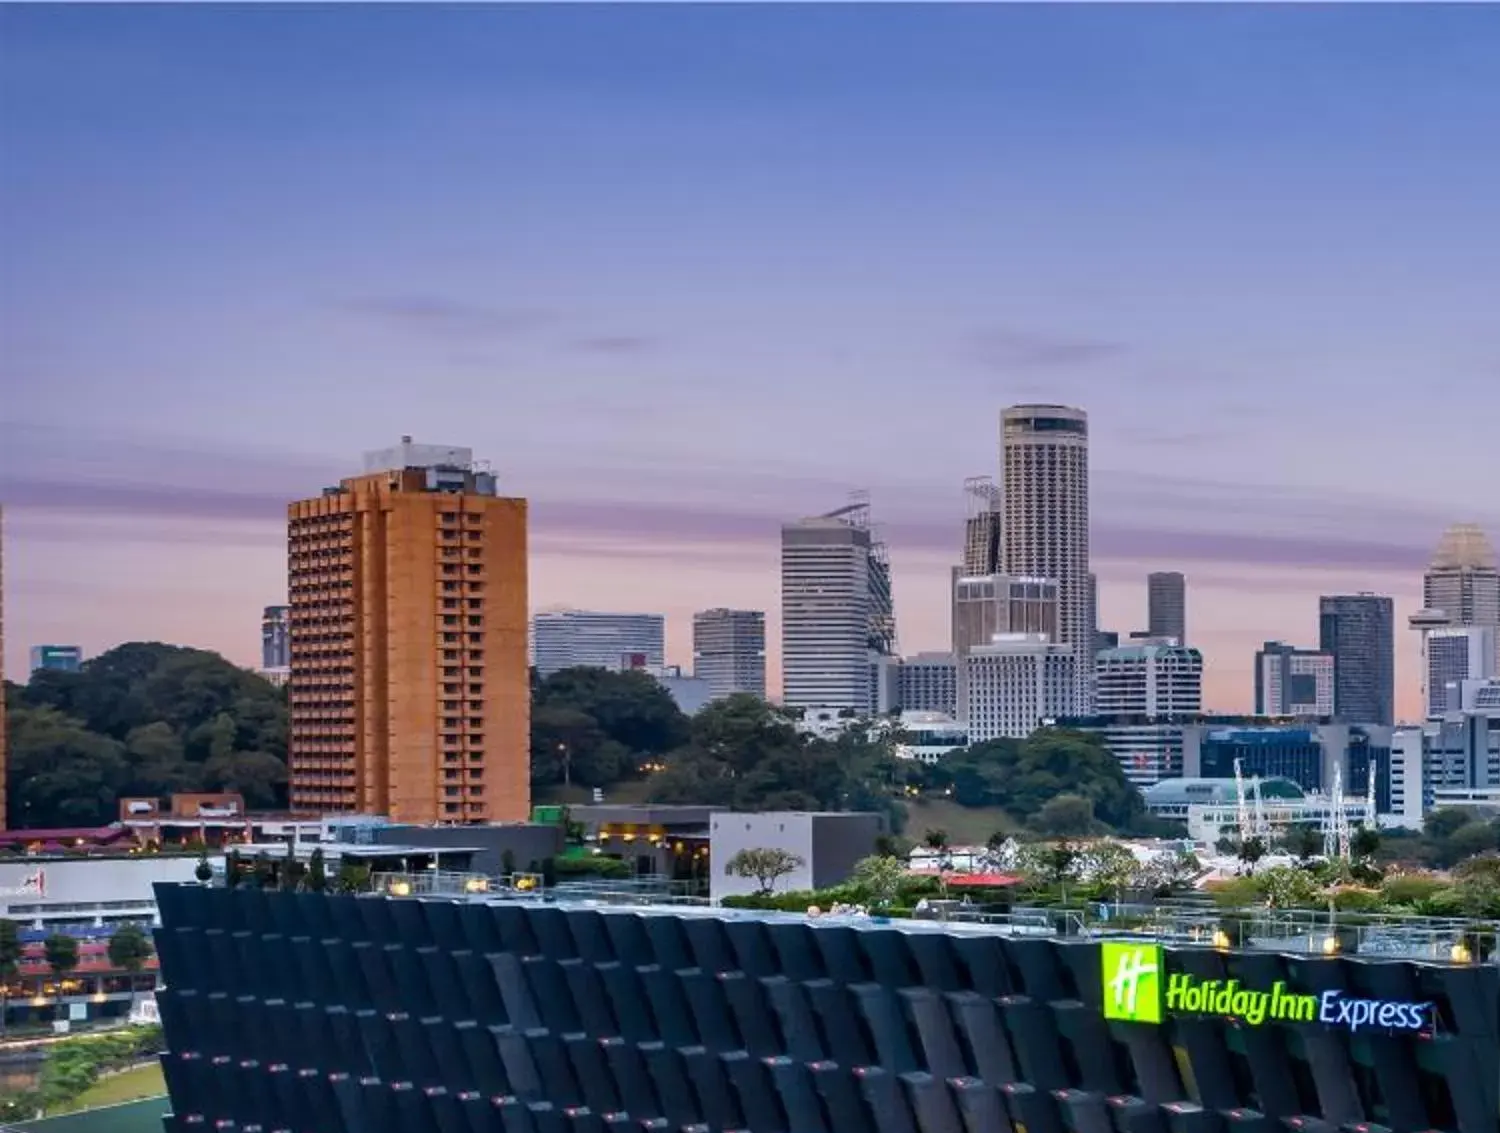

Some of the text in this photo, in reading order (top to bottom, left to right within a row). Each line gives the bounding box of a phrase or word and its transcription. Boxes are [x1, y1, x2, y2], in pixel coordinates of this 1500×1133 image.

[1166, 973, 1426, 1033] Holiday Inn Express
